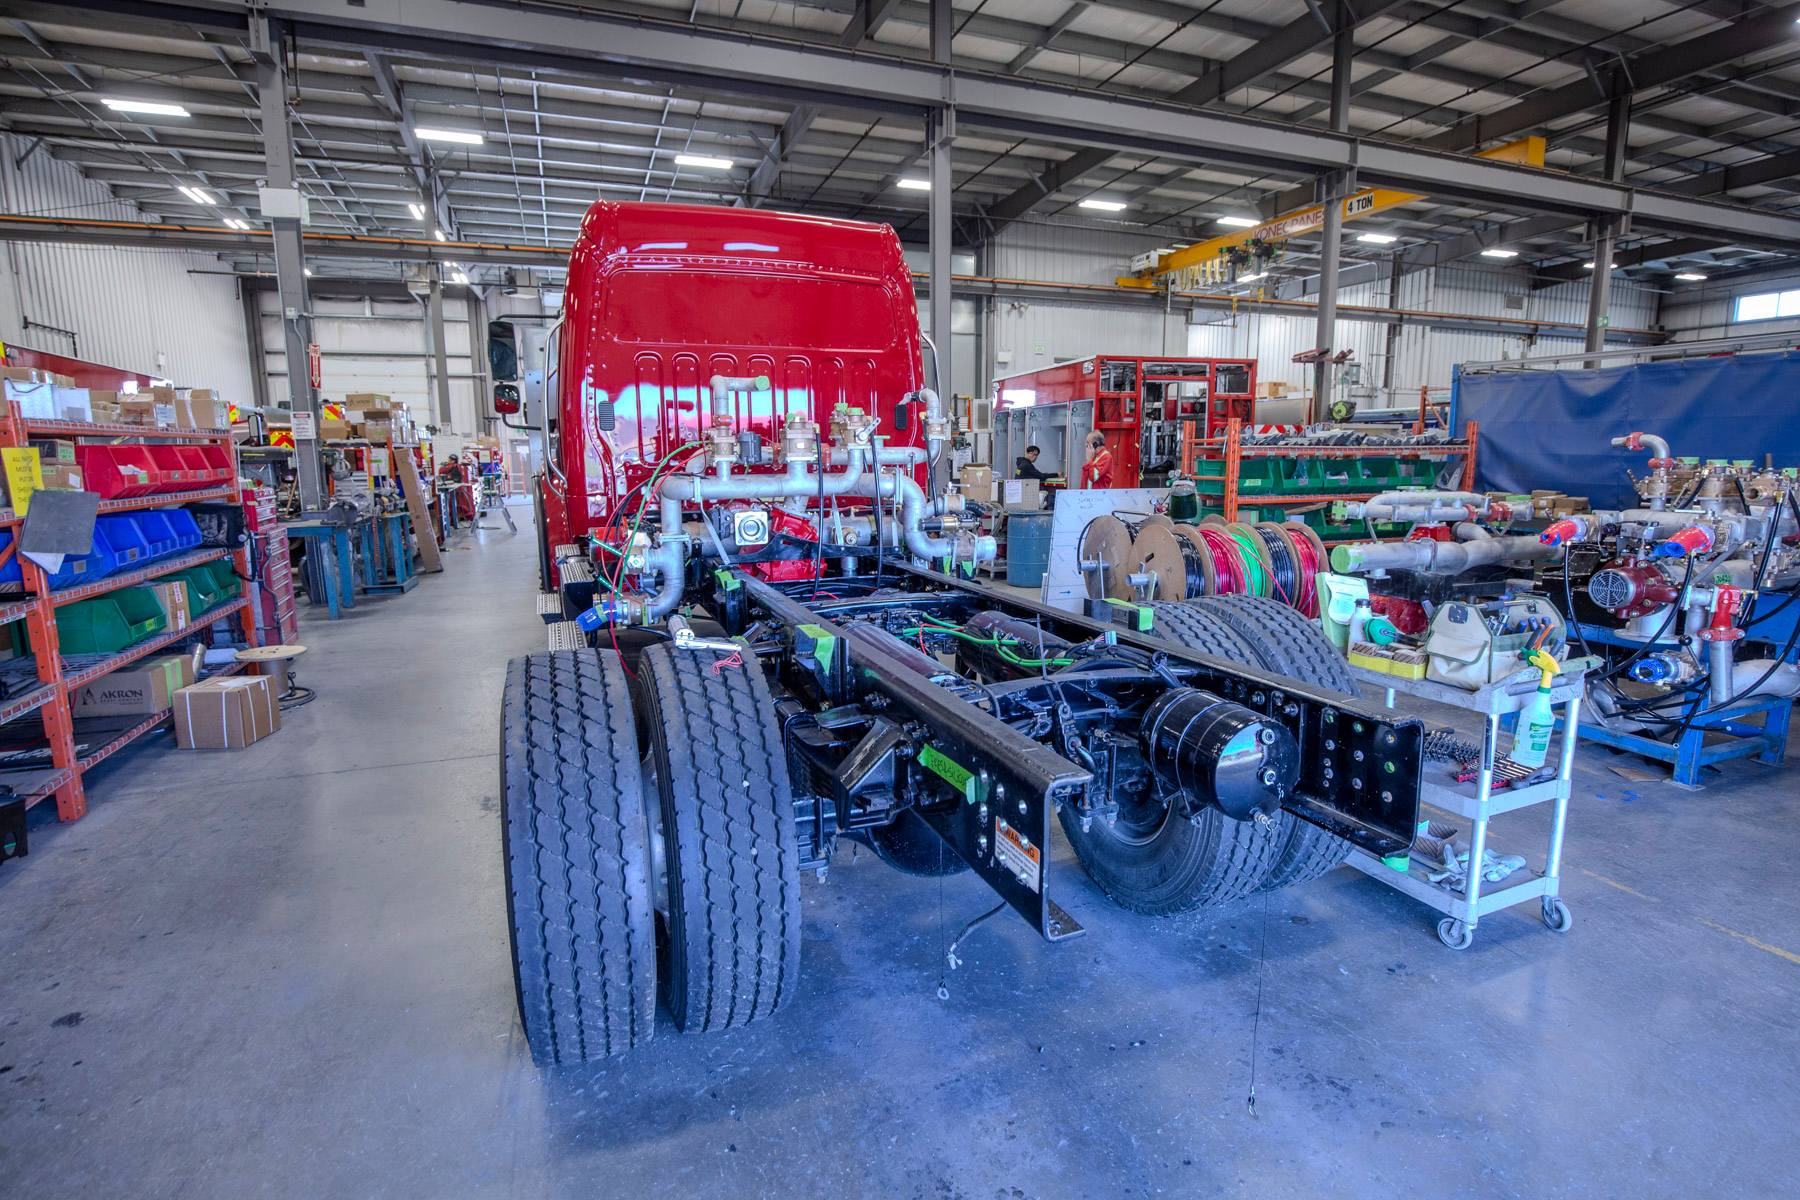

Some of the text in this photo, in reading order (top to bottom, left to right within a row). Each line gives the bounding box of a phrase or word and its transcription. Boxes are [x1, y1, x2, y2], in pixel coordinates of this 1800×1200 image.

[1347, 195, 1373, 213] 4 TON
[100, 690, 143, 699] AKRON
[1003, 829, 1035, 858] WARG
